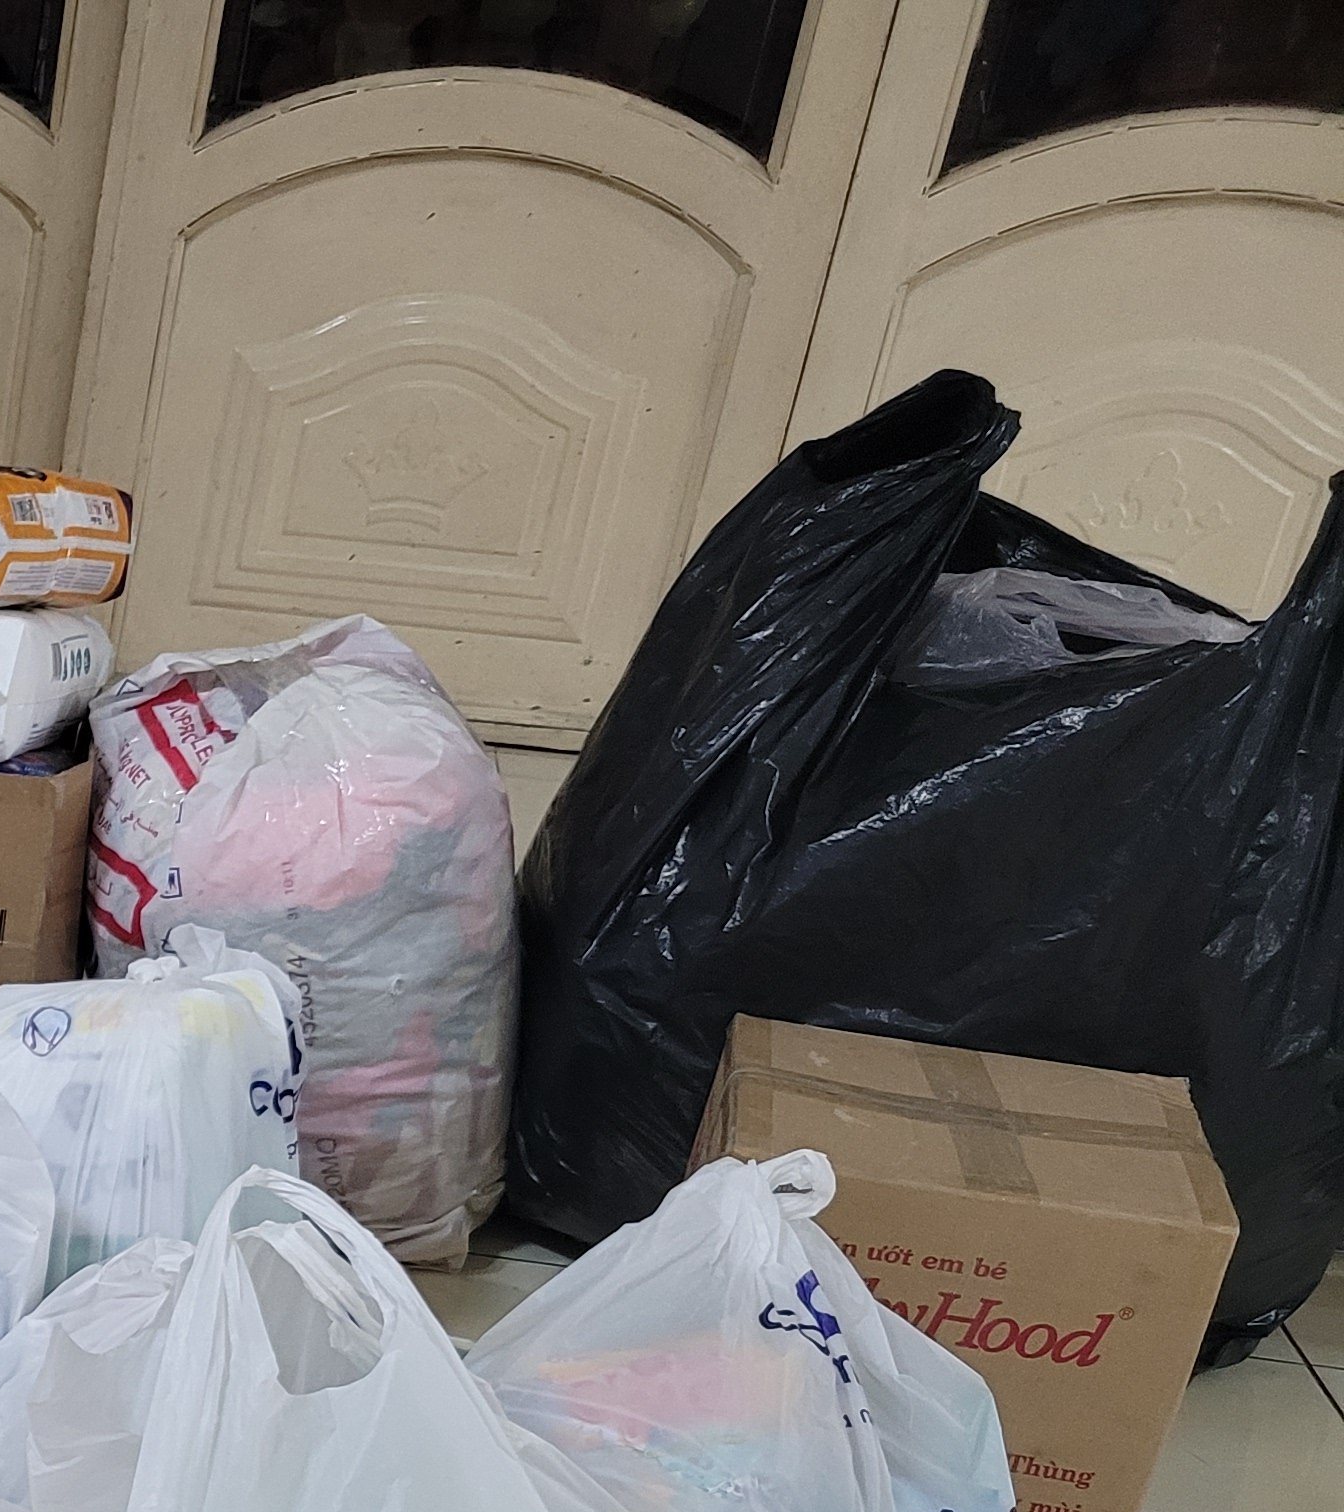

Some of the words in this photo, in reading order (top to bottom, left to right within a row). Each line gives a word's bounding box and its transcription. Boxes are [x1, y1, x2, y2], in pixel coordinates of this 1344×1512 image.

[127, 763, 153, 789] NET
[865, 1243, 913, 1267] ướt
[920, 1253, 964, 1274] em
[973, 1255, 1009, 1282] bé
[1008, 1453, 1096, 1489] Thùng
